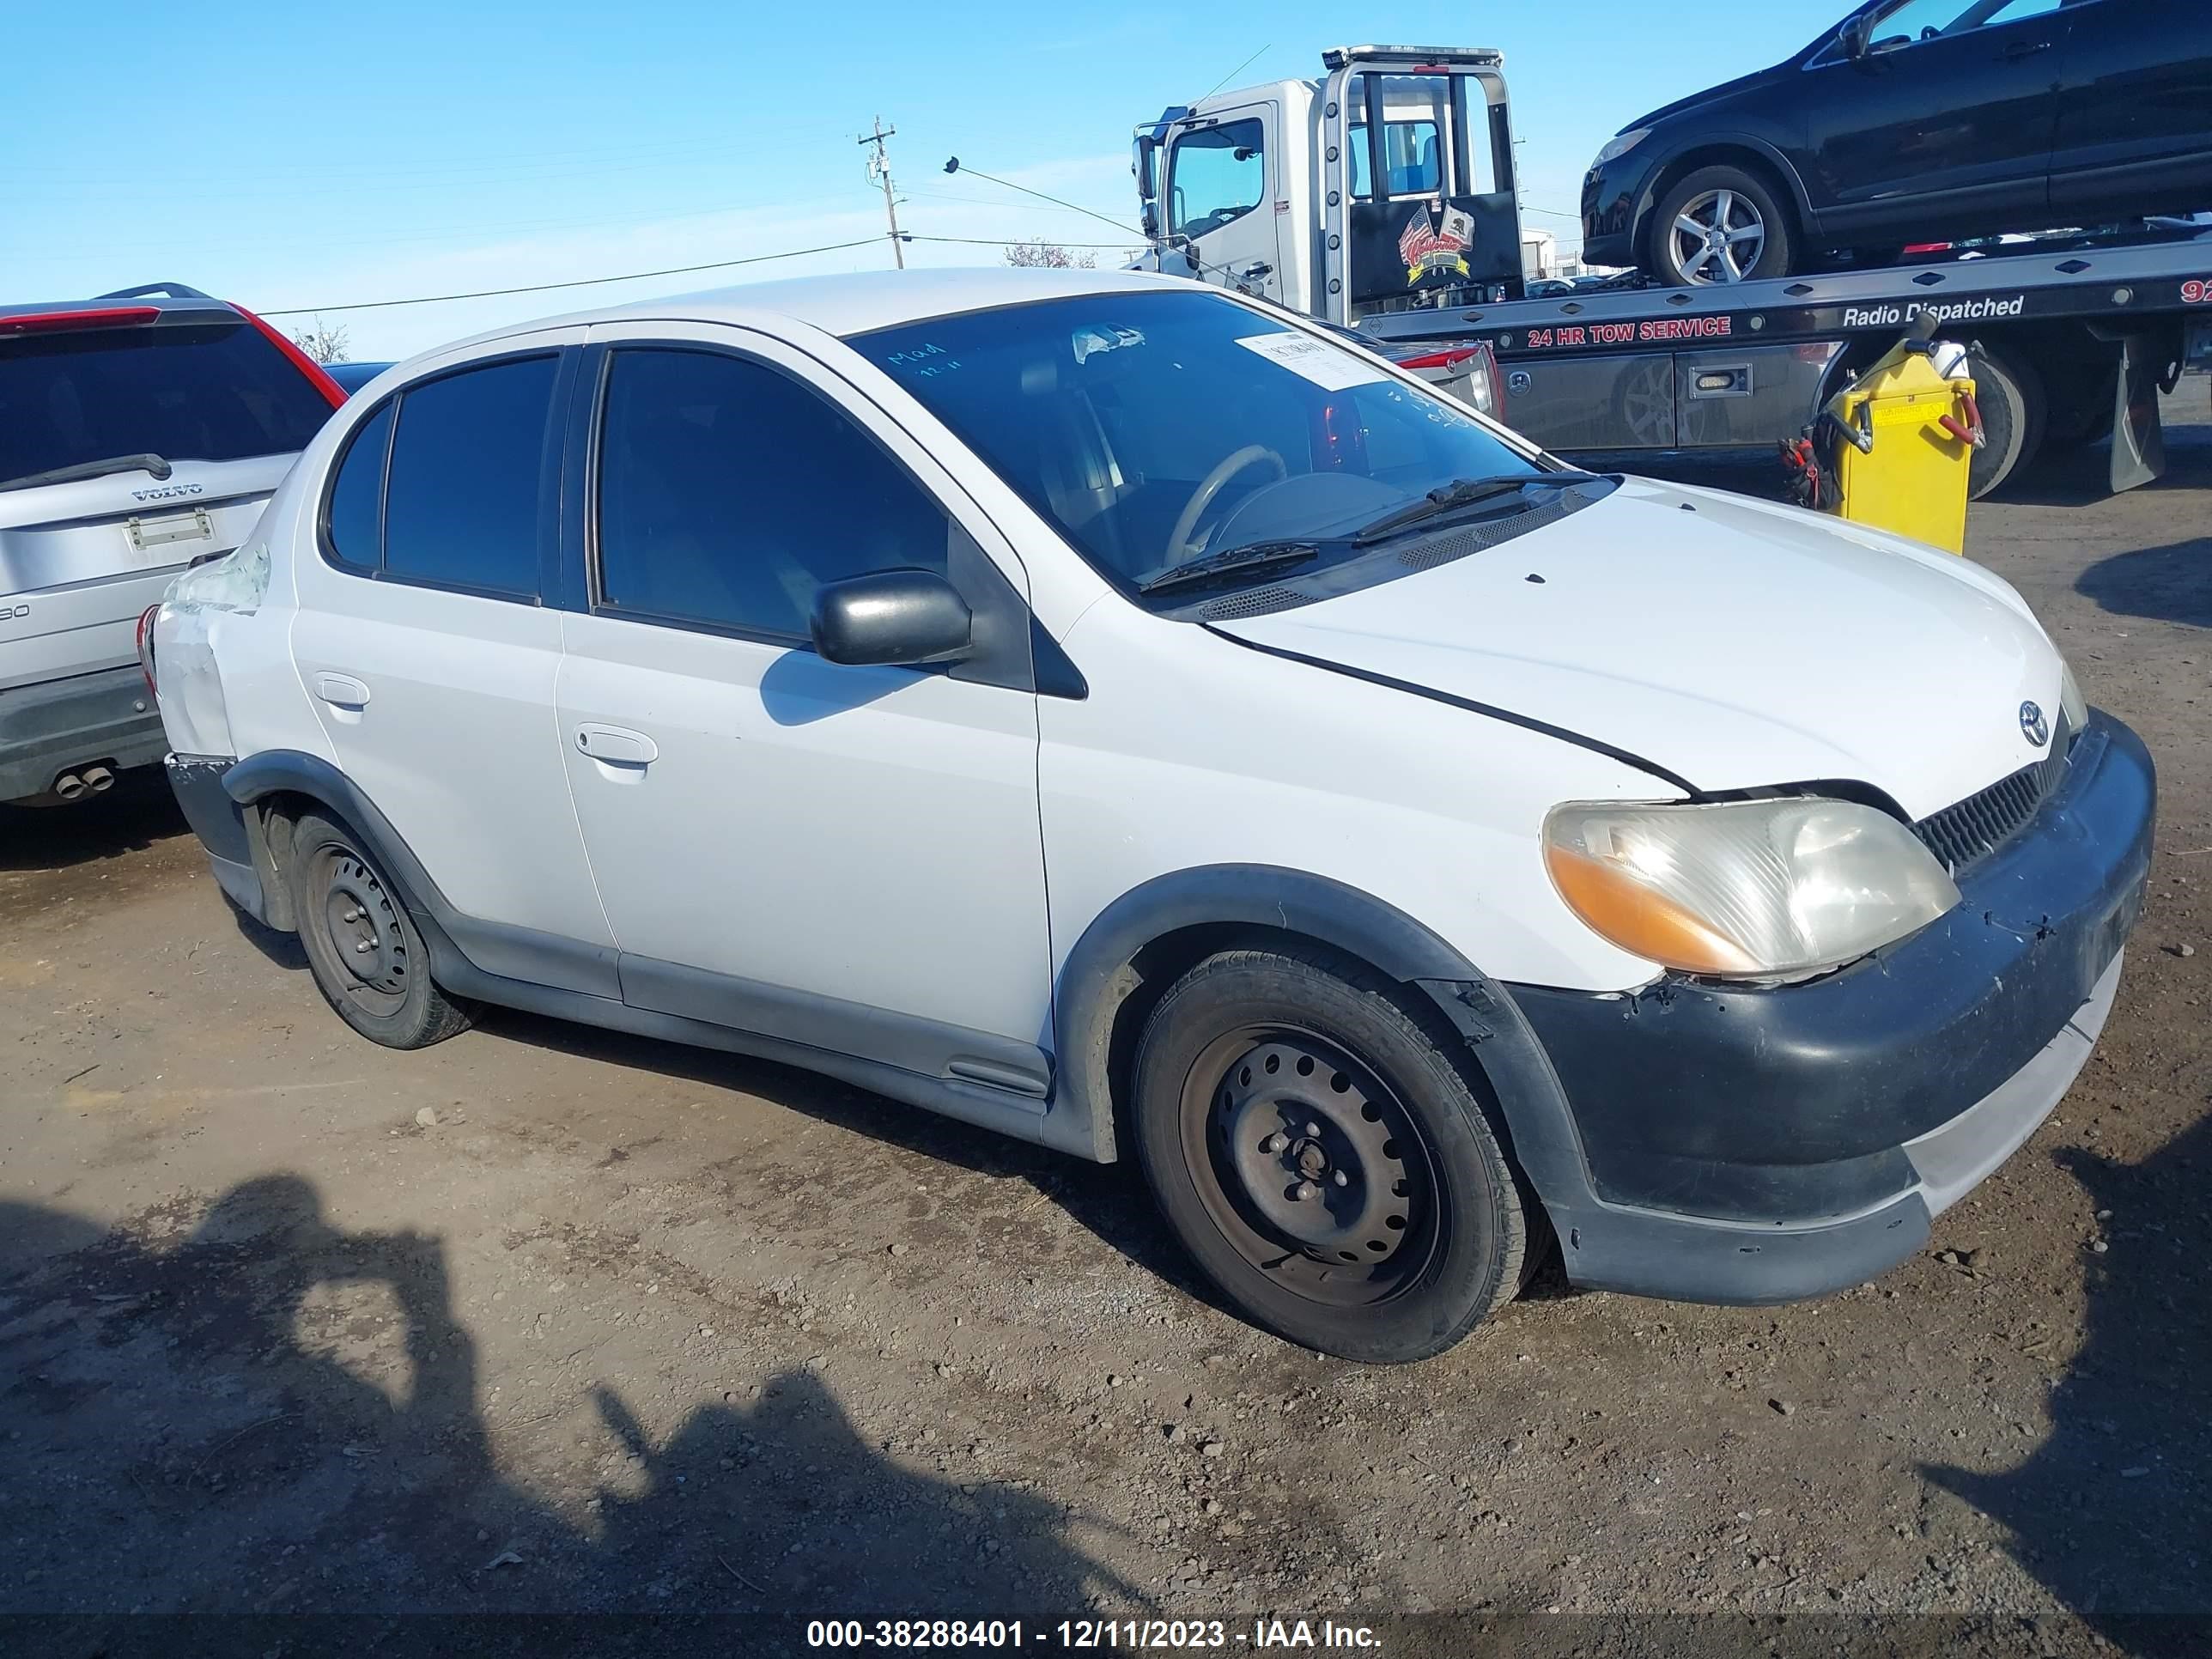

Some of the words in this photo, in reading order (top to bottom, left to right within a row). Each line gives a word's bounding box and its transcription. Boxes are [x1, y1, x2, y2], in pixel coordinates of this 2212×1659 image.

[1843, 306, 1900, 327] Radio
[1528, 330, 1552, 347] 24
[1557, 327, 1585, 345] HR
[1589, 323, 1636, 343] TOW
[1640, 316, 1731, 340] SERVICE
[131, 483, 203, 501] VOLVO
